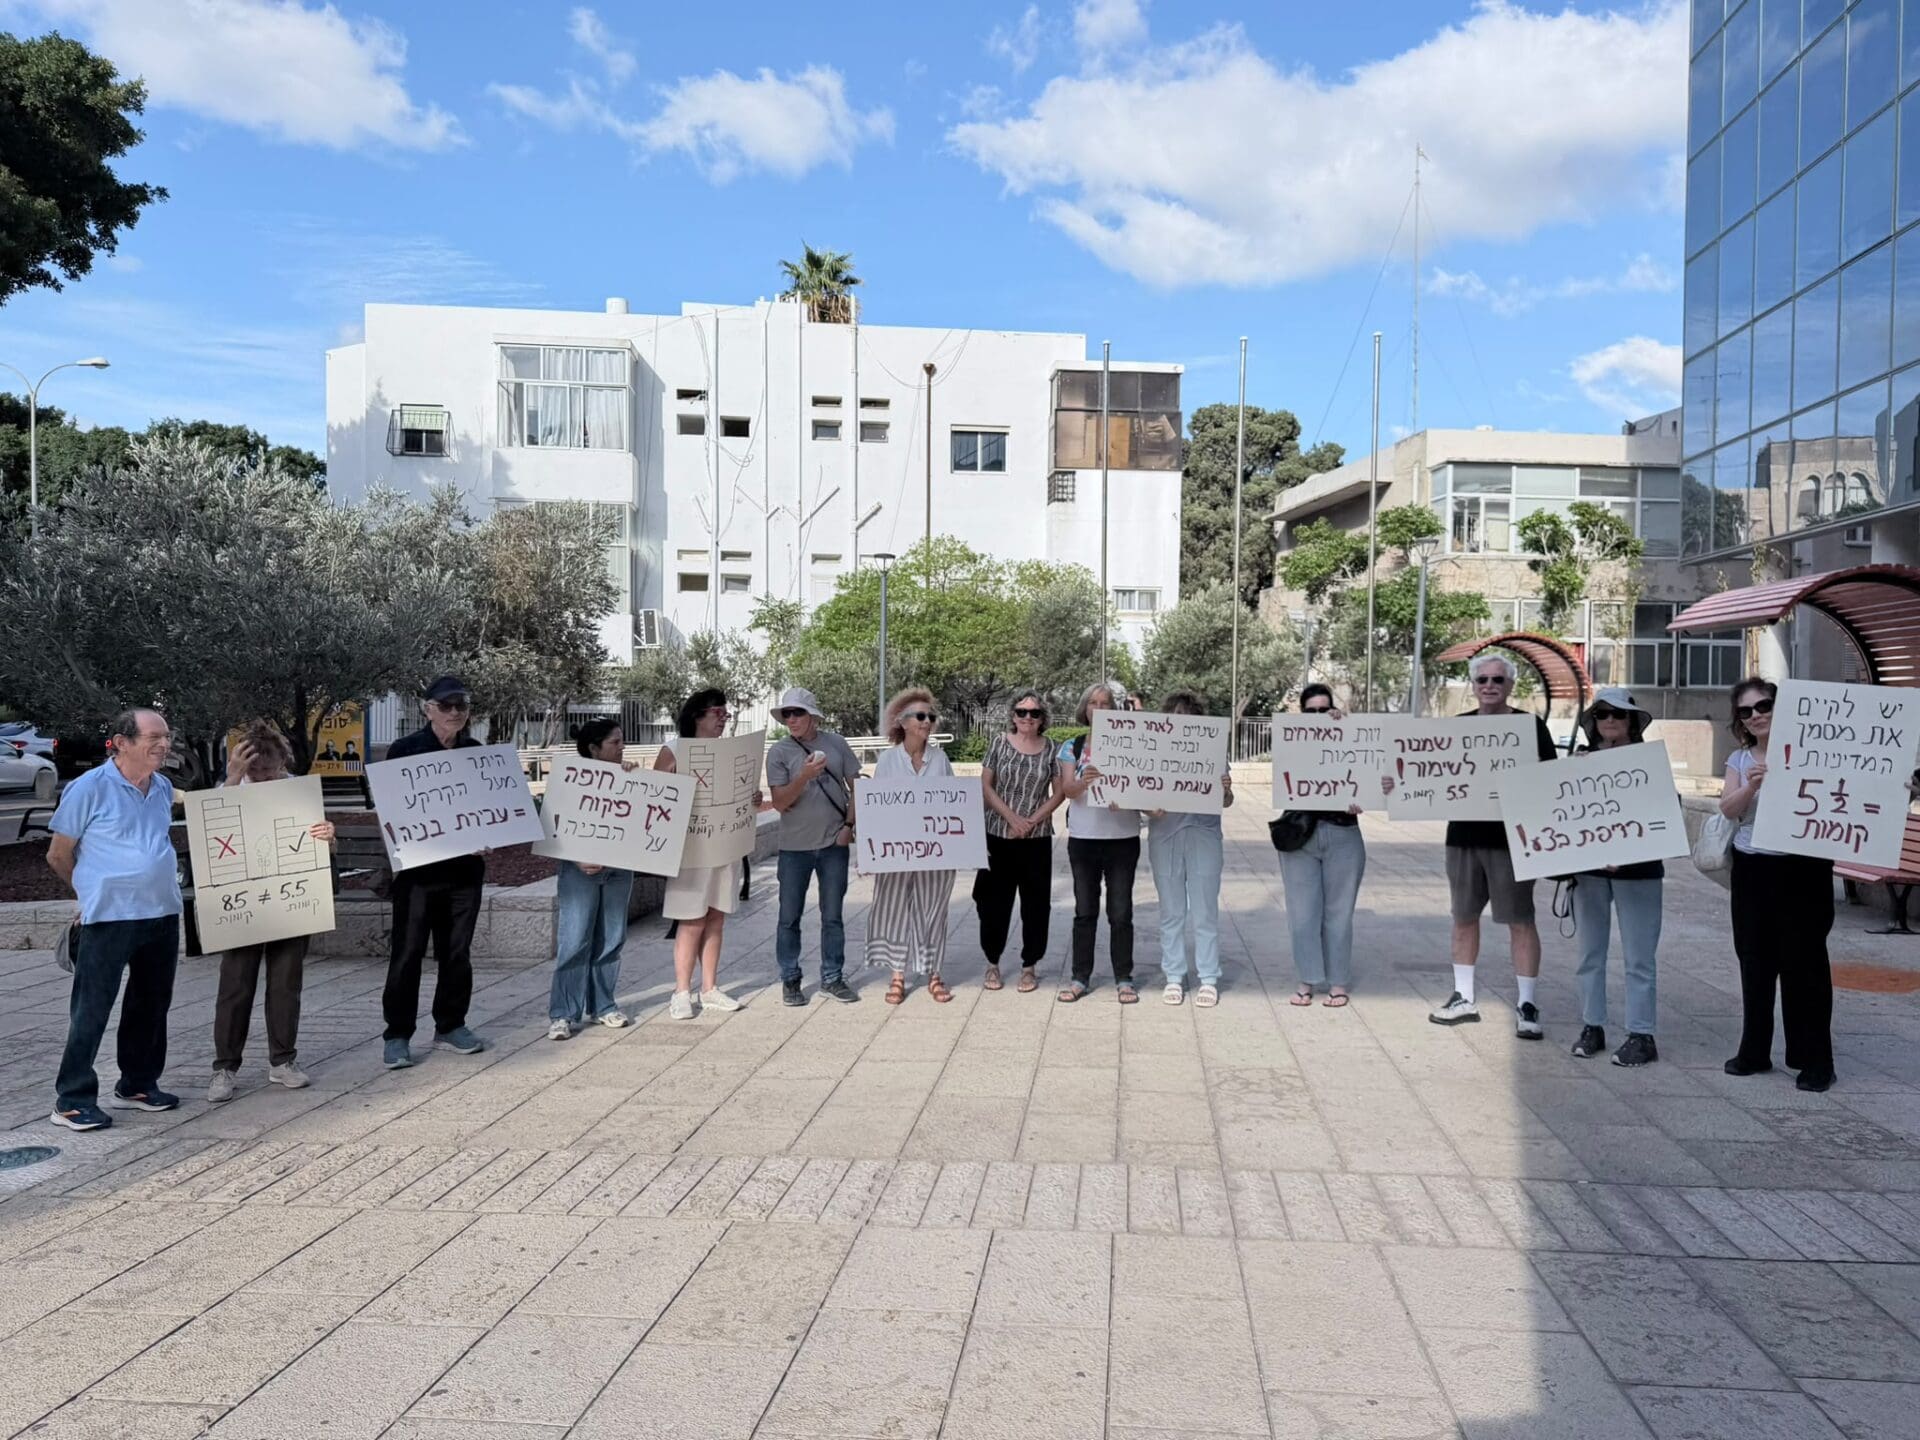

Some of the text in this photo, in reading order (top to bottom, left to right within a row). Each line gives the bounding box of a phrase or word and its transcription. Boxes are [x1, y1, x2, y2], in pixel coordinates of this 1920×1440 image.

[1797, 688, 1903, 721] יש לקיים
[1107, 718, 1136, 730] היתר
[1143, 716, 1174, 734] לאחר
[1283, 727, 1343, 741] האזרחים
[1138, 733, 1157, 750] בלי
[1462, 732, 1520, 749] מתחם
[1796, 722, 1903, 748] את מסמך
[1171, 740, 1199, 753] ובניה
[1160, 758, 1215, 775] ולתושבים
[1319, 749, 1386, 770] קודמות
[1490, 758, 1516, 772] הוא
[401, 754, 507, 790] היתר מרתף
[564, 766, 615, 790] חיפה
[405, 772, 518, 813] מעל הקרקע
[1099, 774, 1212, 795] עוגמת נפש קשה
[1555, 768, 1649, 800] הפקרות
[864, 790, 967, 806] העירייה מאשרת
[454, 807, 509, 831] עבירת
[1552, 800, 1621, 822] בבניה
[923, 816, 965, 835] בניה
[1791, 819, 1869, 853] קומות
[645, 830, 668, 852] על
[279, 879, 309, 900] 5.5
